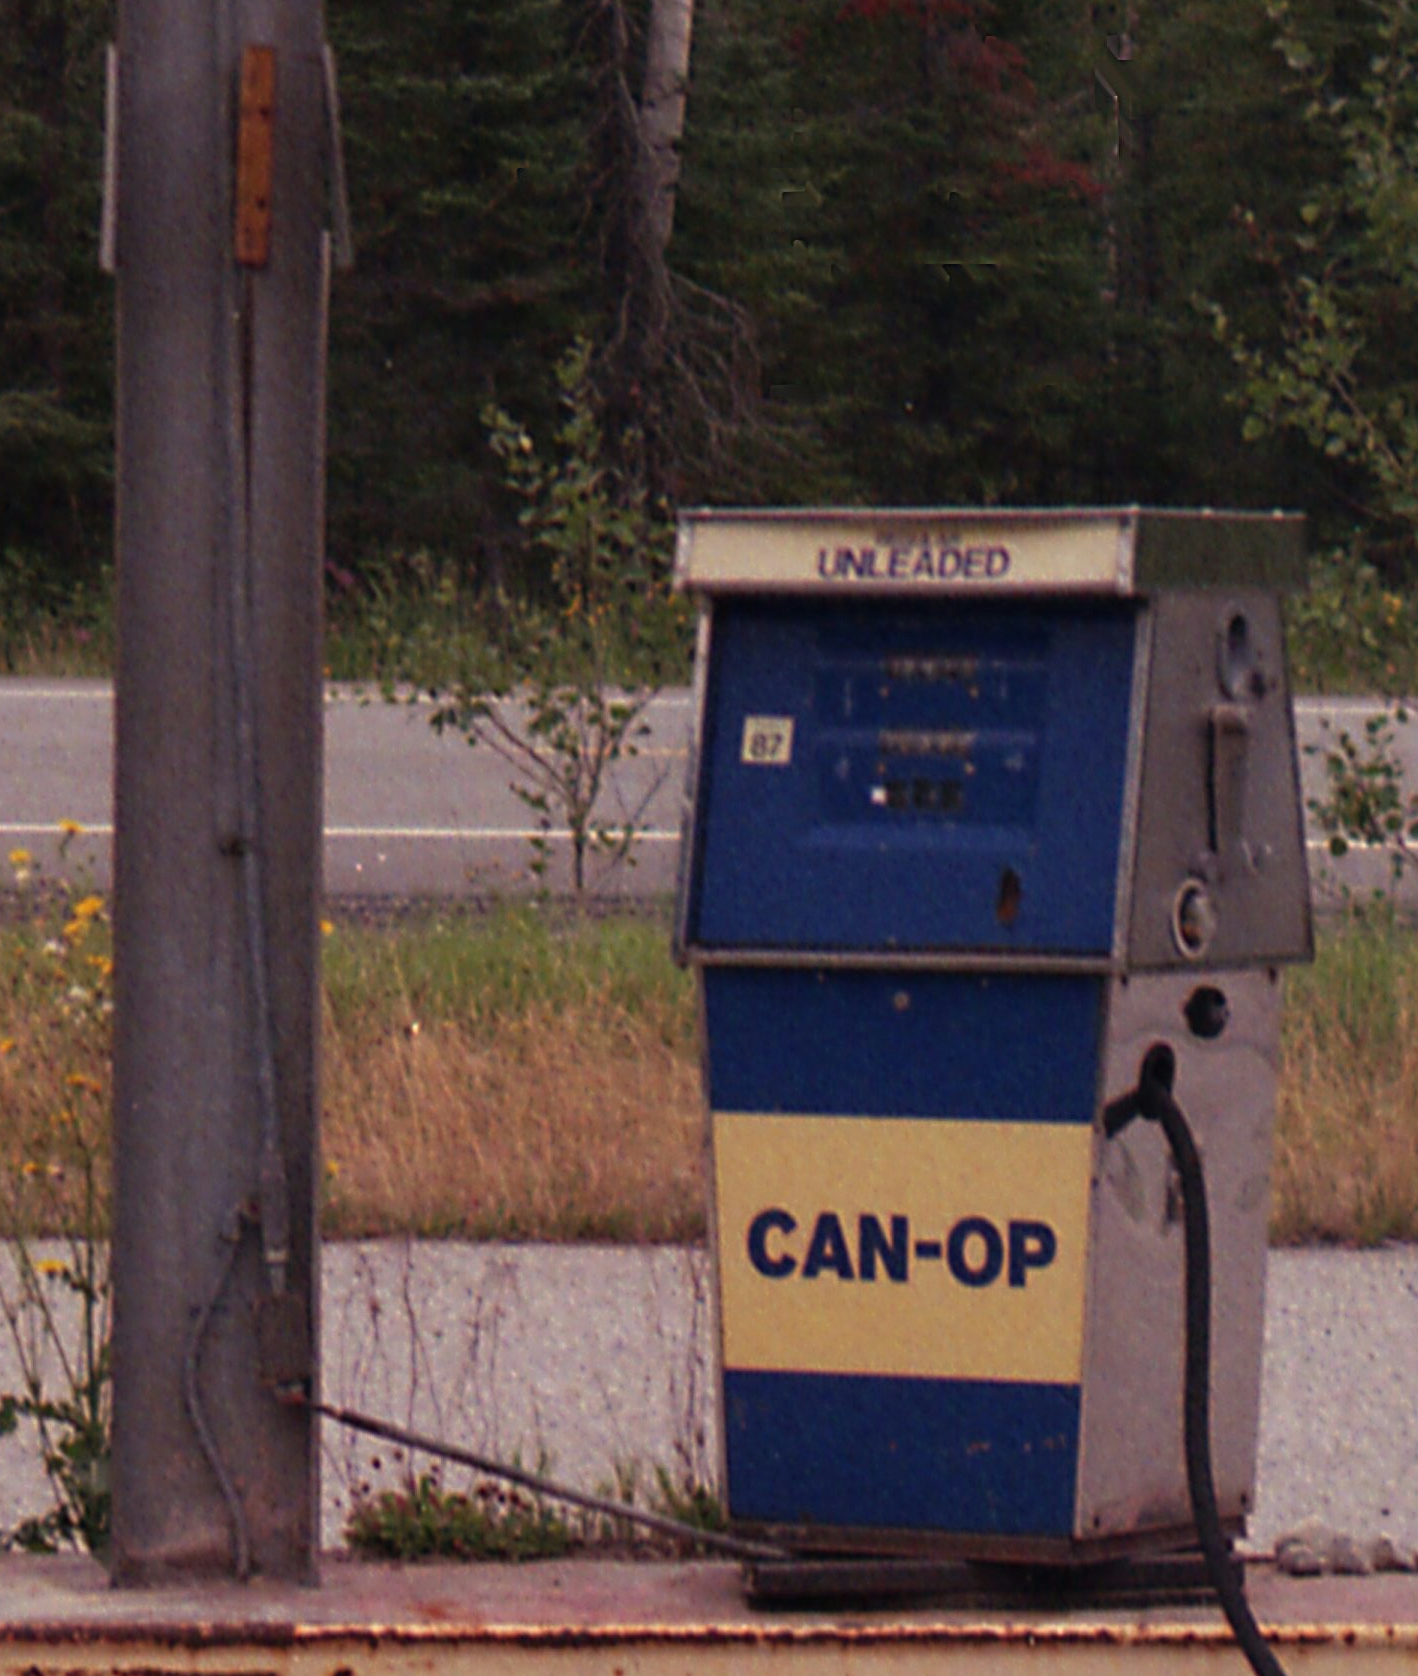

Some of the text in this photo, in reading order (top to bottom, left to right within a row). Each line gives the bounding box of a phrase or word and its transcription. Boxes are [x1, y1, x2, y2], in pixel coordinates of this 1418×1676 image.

[817, 545, 1012, 578] UNLEADED
[750, 732, 784, 759] 87
[746, 1207, 1058, 1288] CAN-OP
